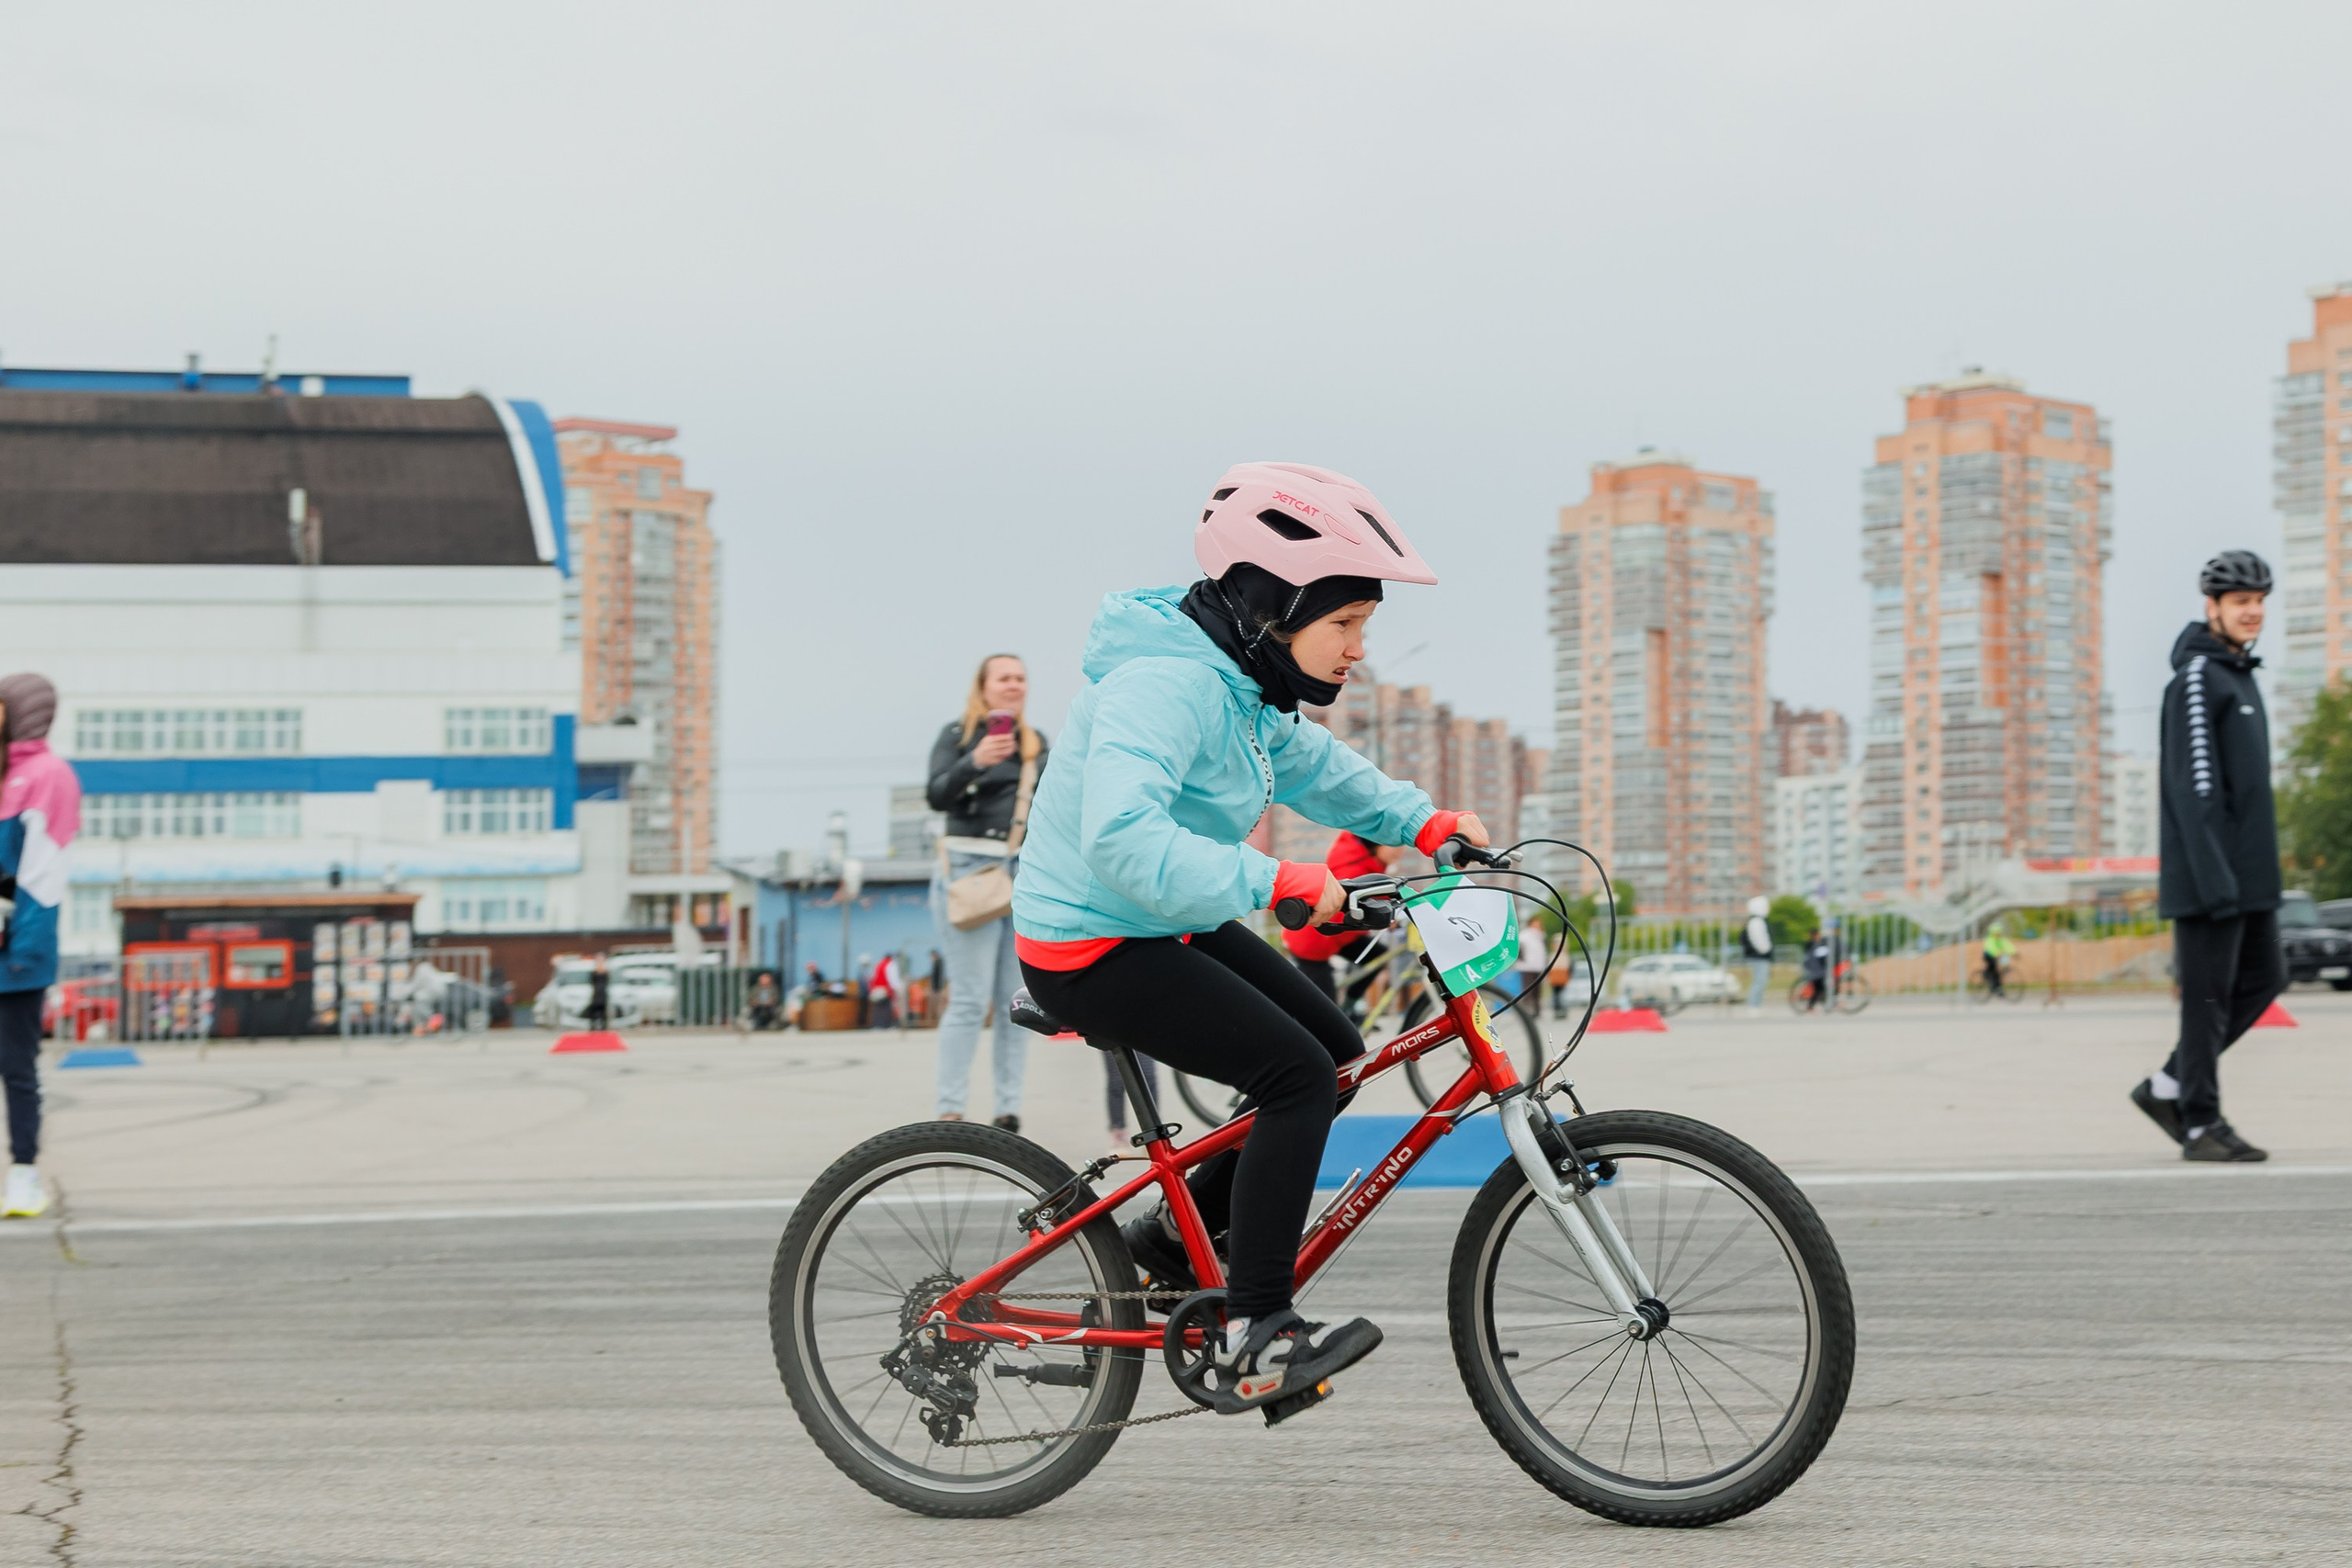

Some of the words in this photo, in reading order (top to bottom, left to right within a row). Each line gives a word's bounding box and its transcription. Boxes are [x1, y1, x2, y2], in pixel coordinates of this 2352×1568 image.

[1272, 491, 1320, 517] JETCAT
[1012, 998, 1046, 1018] SADDLE
[1391, 1025, 1441, 1056] MORS
